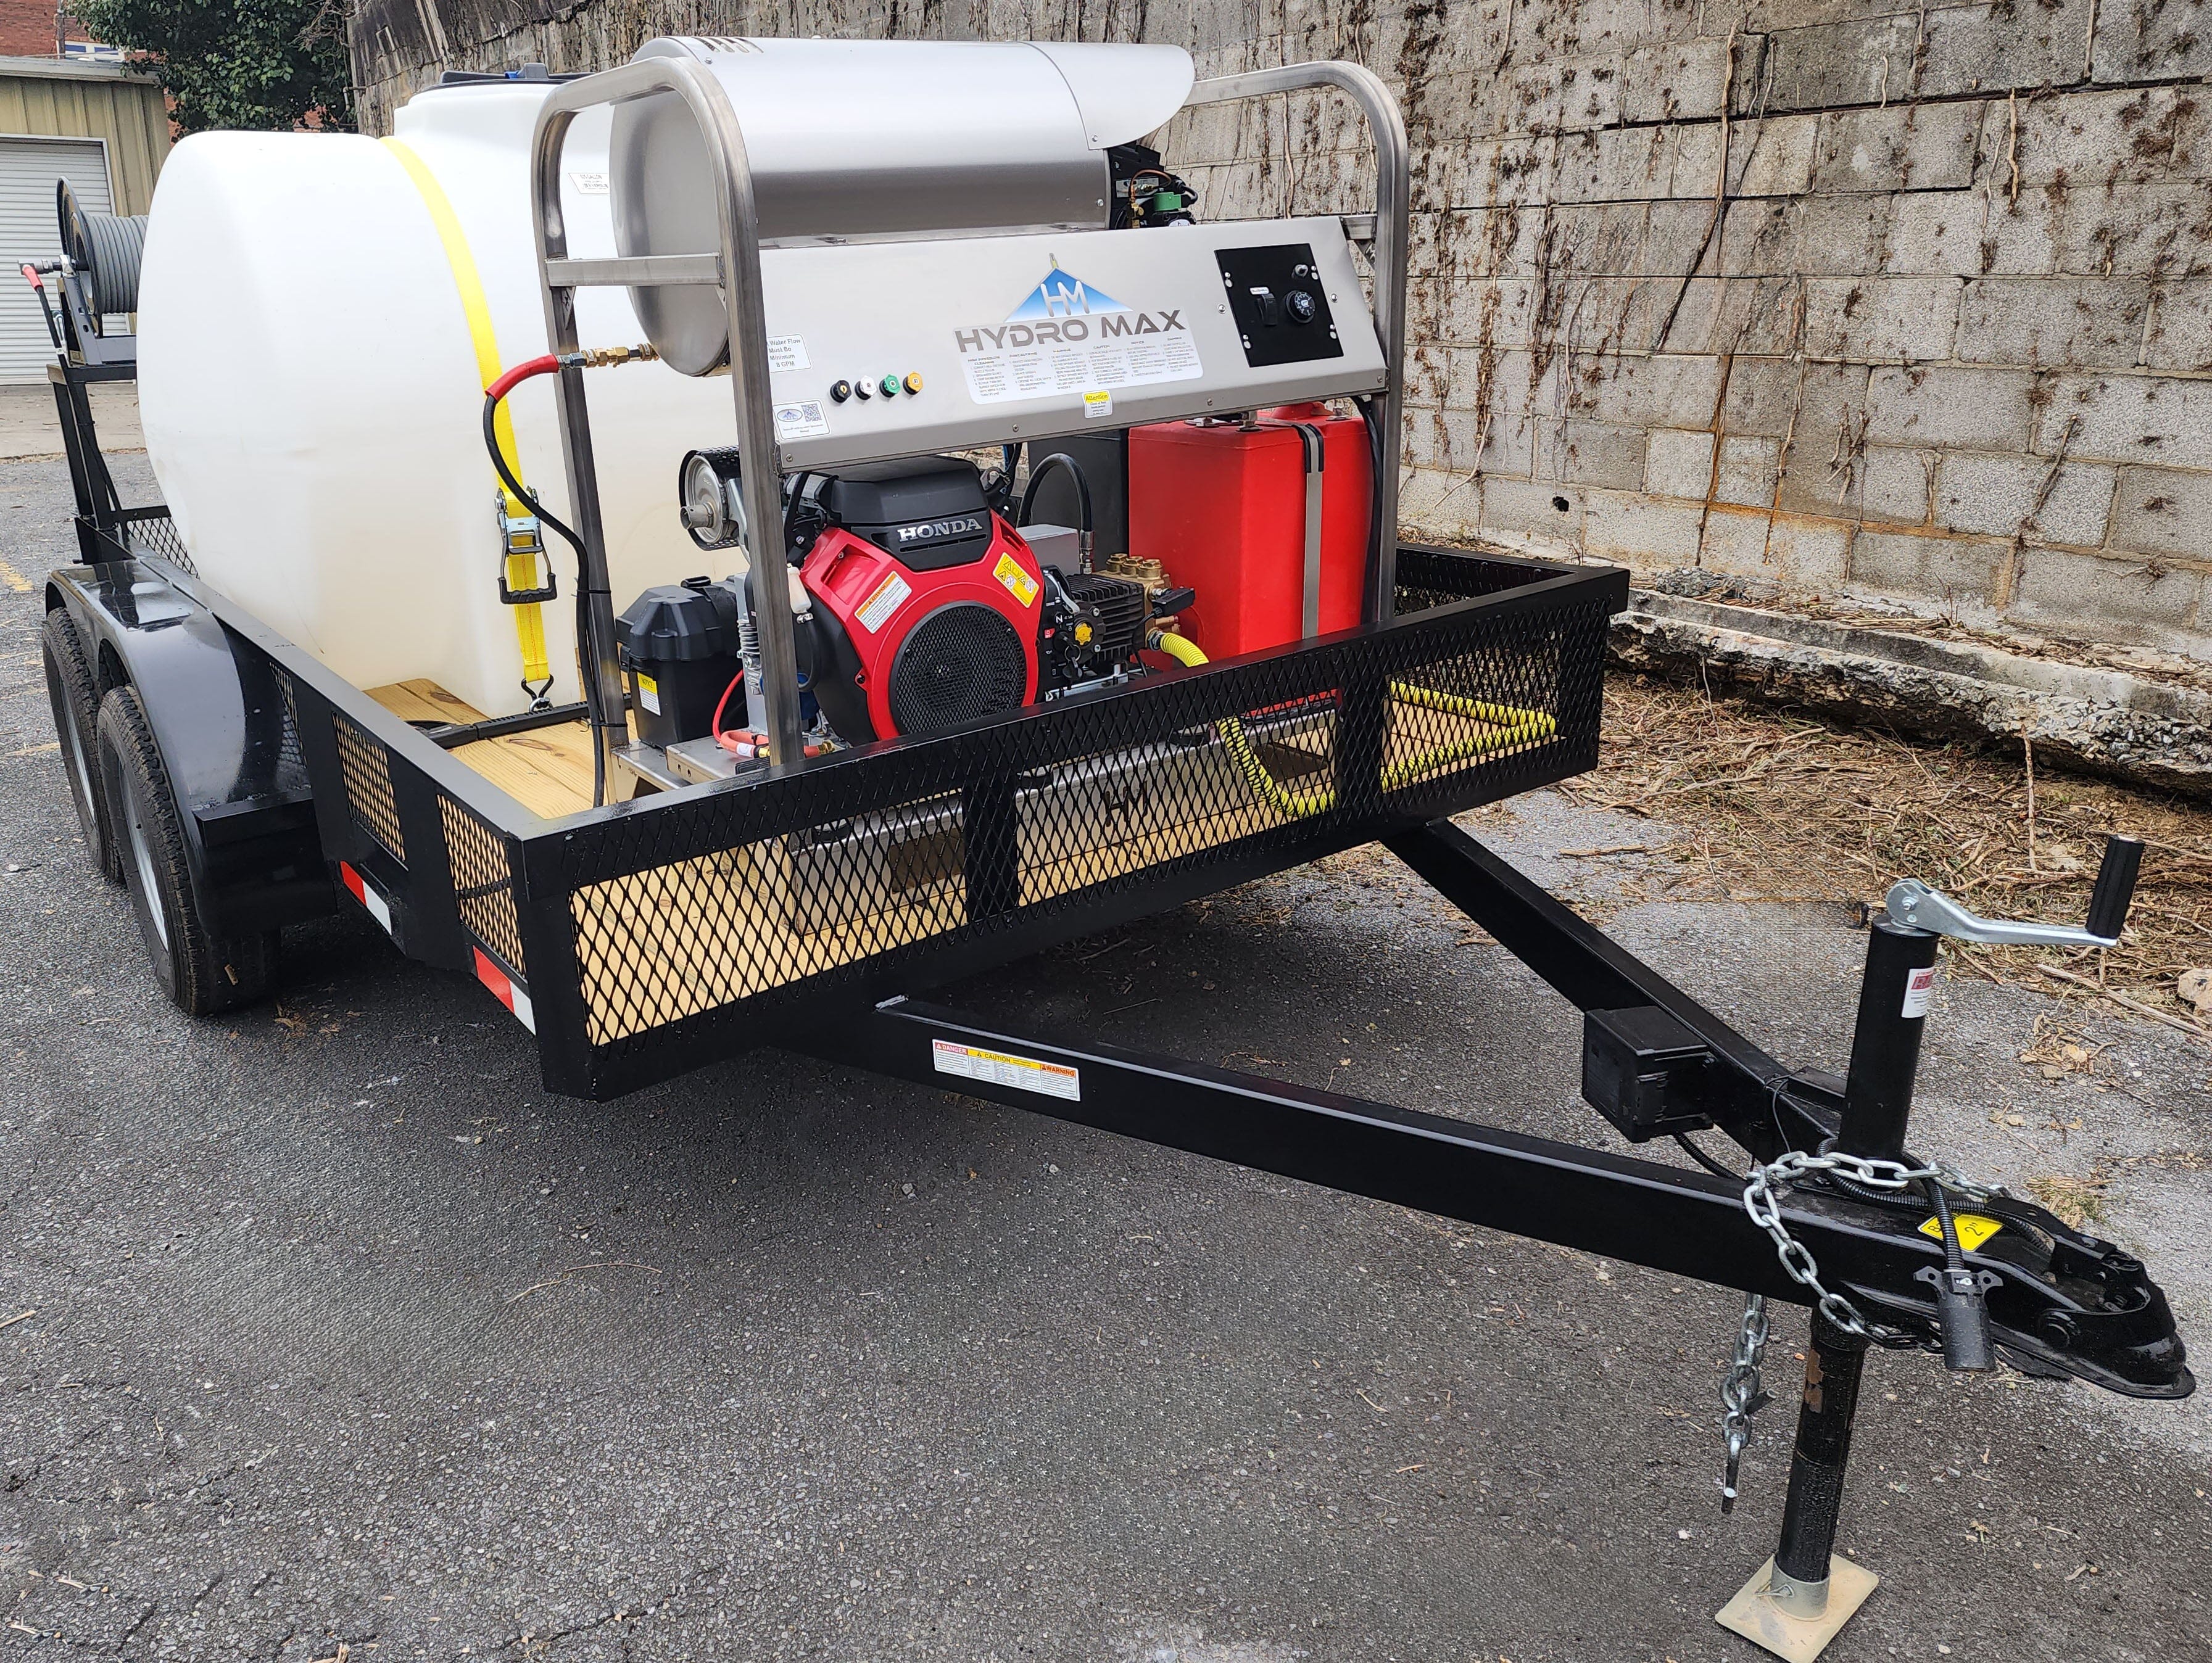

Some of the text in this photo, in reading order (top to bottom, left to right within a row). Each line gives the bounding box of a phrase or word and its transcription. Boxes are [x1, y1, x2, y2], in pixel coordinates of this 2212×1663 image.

[1040, 280, 1090, 317] HM
[955, 310, 1187, 353] HYDRO MAX
[1085, 394, 1108, 402] Attention
[897, 518, 983, 542] HONDA
[942, 1044, 967, 1054] DANGER
[984, 1053, 1011, 1063] CAUTION
[1046, 1065, 1075, 1076] WARNING
